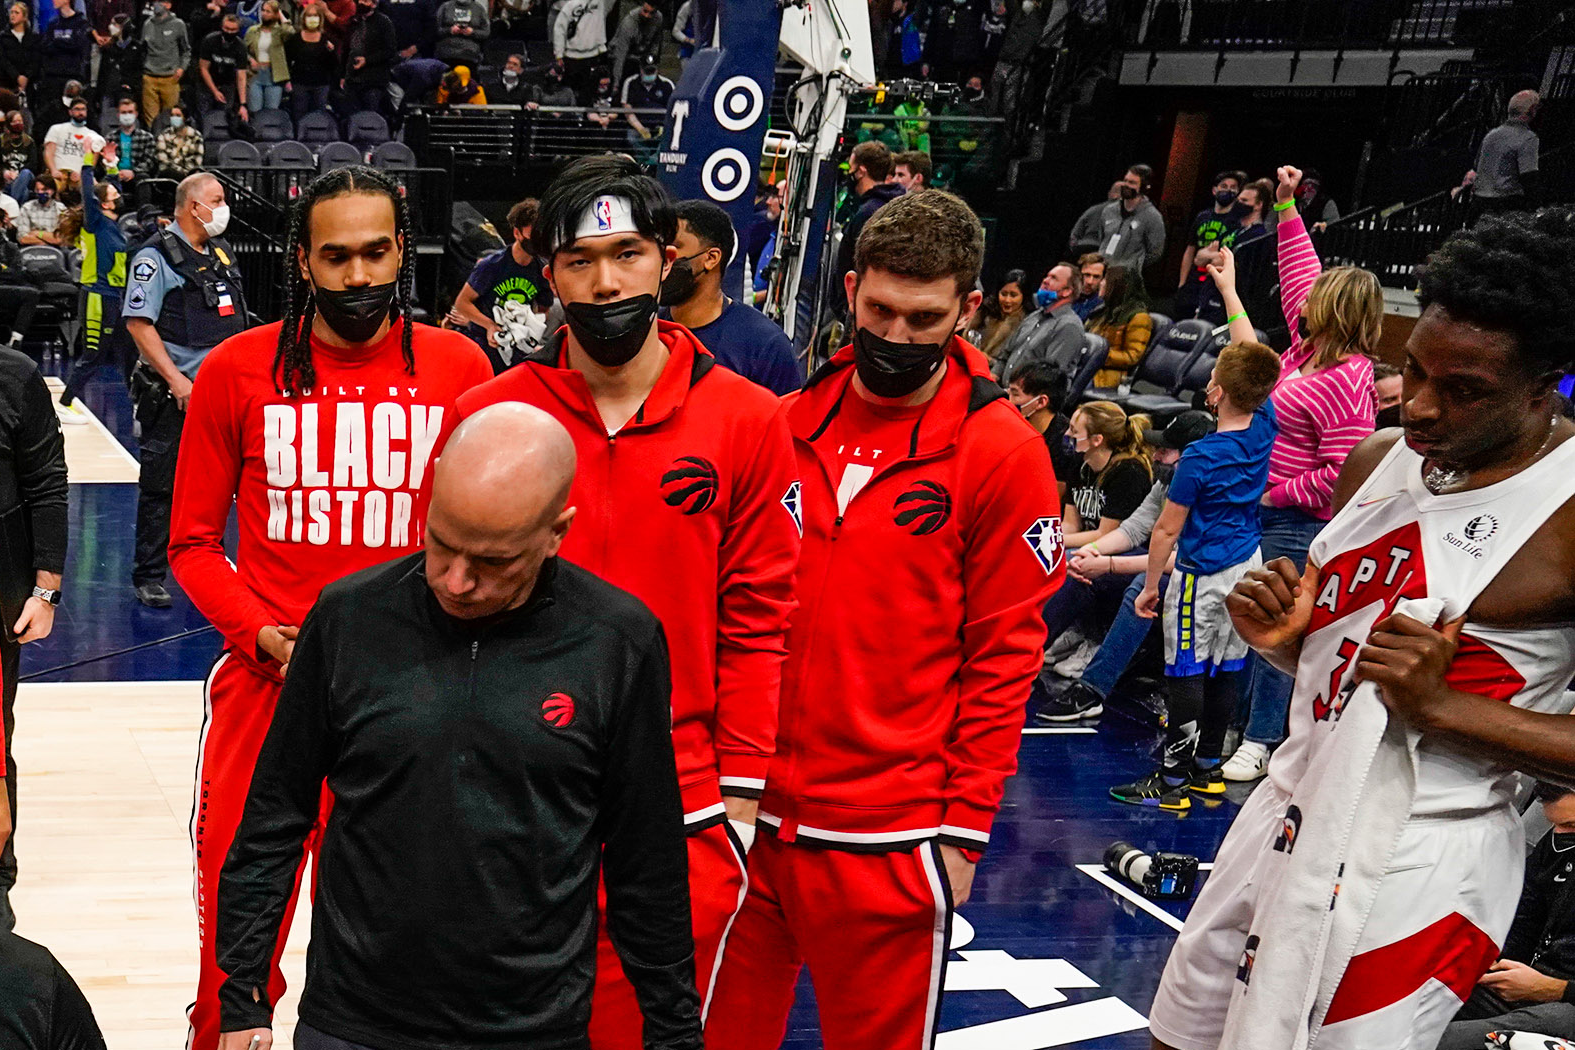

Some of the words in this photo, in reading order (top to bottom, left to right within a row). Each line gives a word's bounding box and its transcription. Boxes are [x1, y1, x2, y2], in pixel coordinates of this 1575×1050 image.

[389, 386, 418, 398] BY
[263, 402, 445, 489] BLACK
[837, 444, 883, 459] ILT
[267, 489, 420, 548] HISTOR
[1442, 532, 1464, 548] Sun
[1462, 542, 1483, 560] Life
[197, 780, 211, 858] TORONTO
